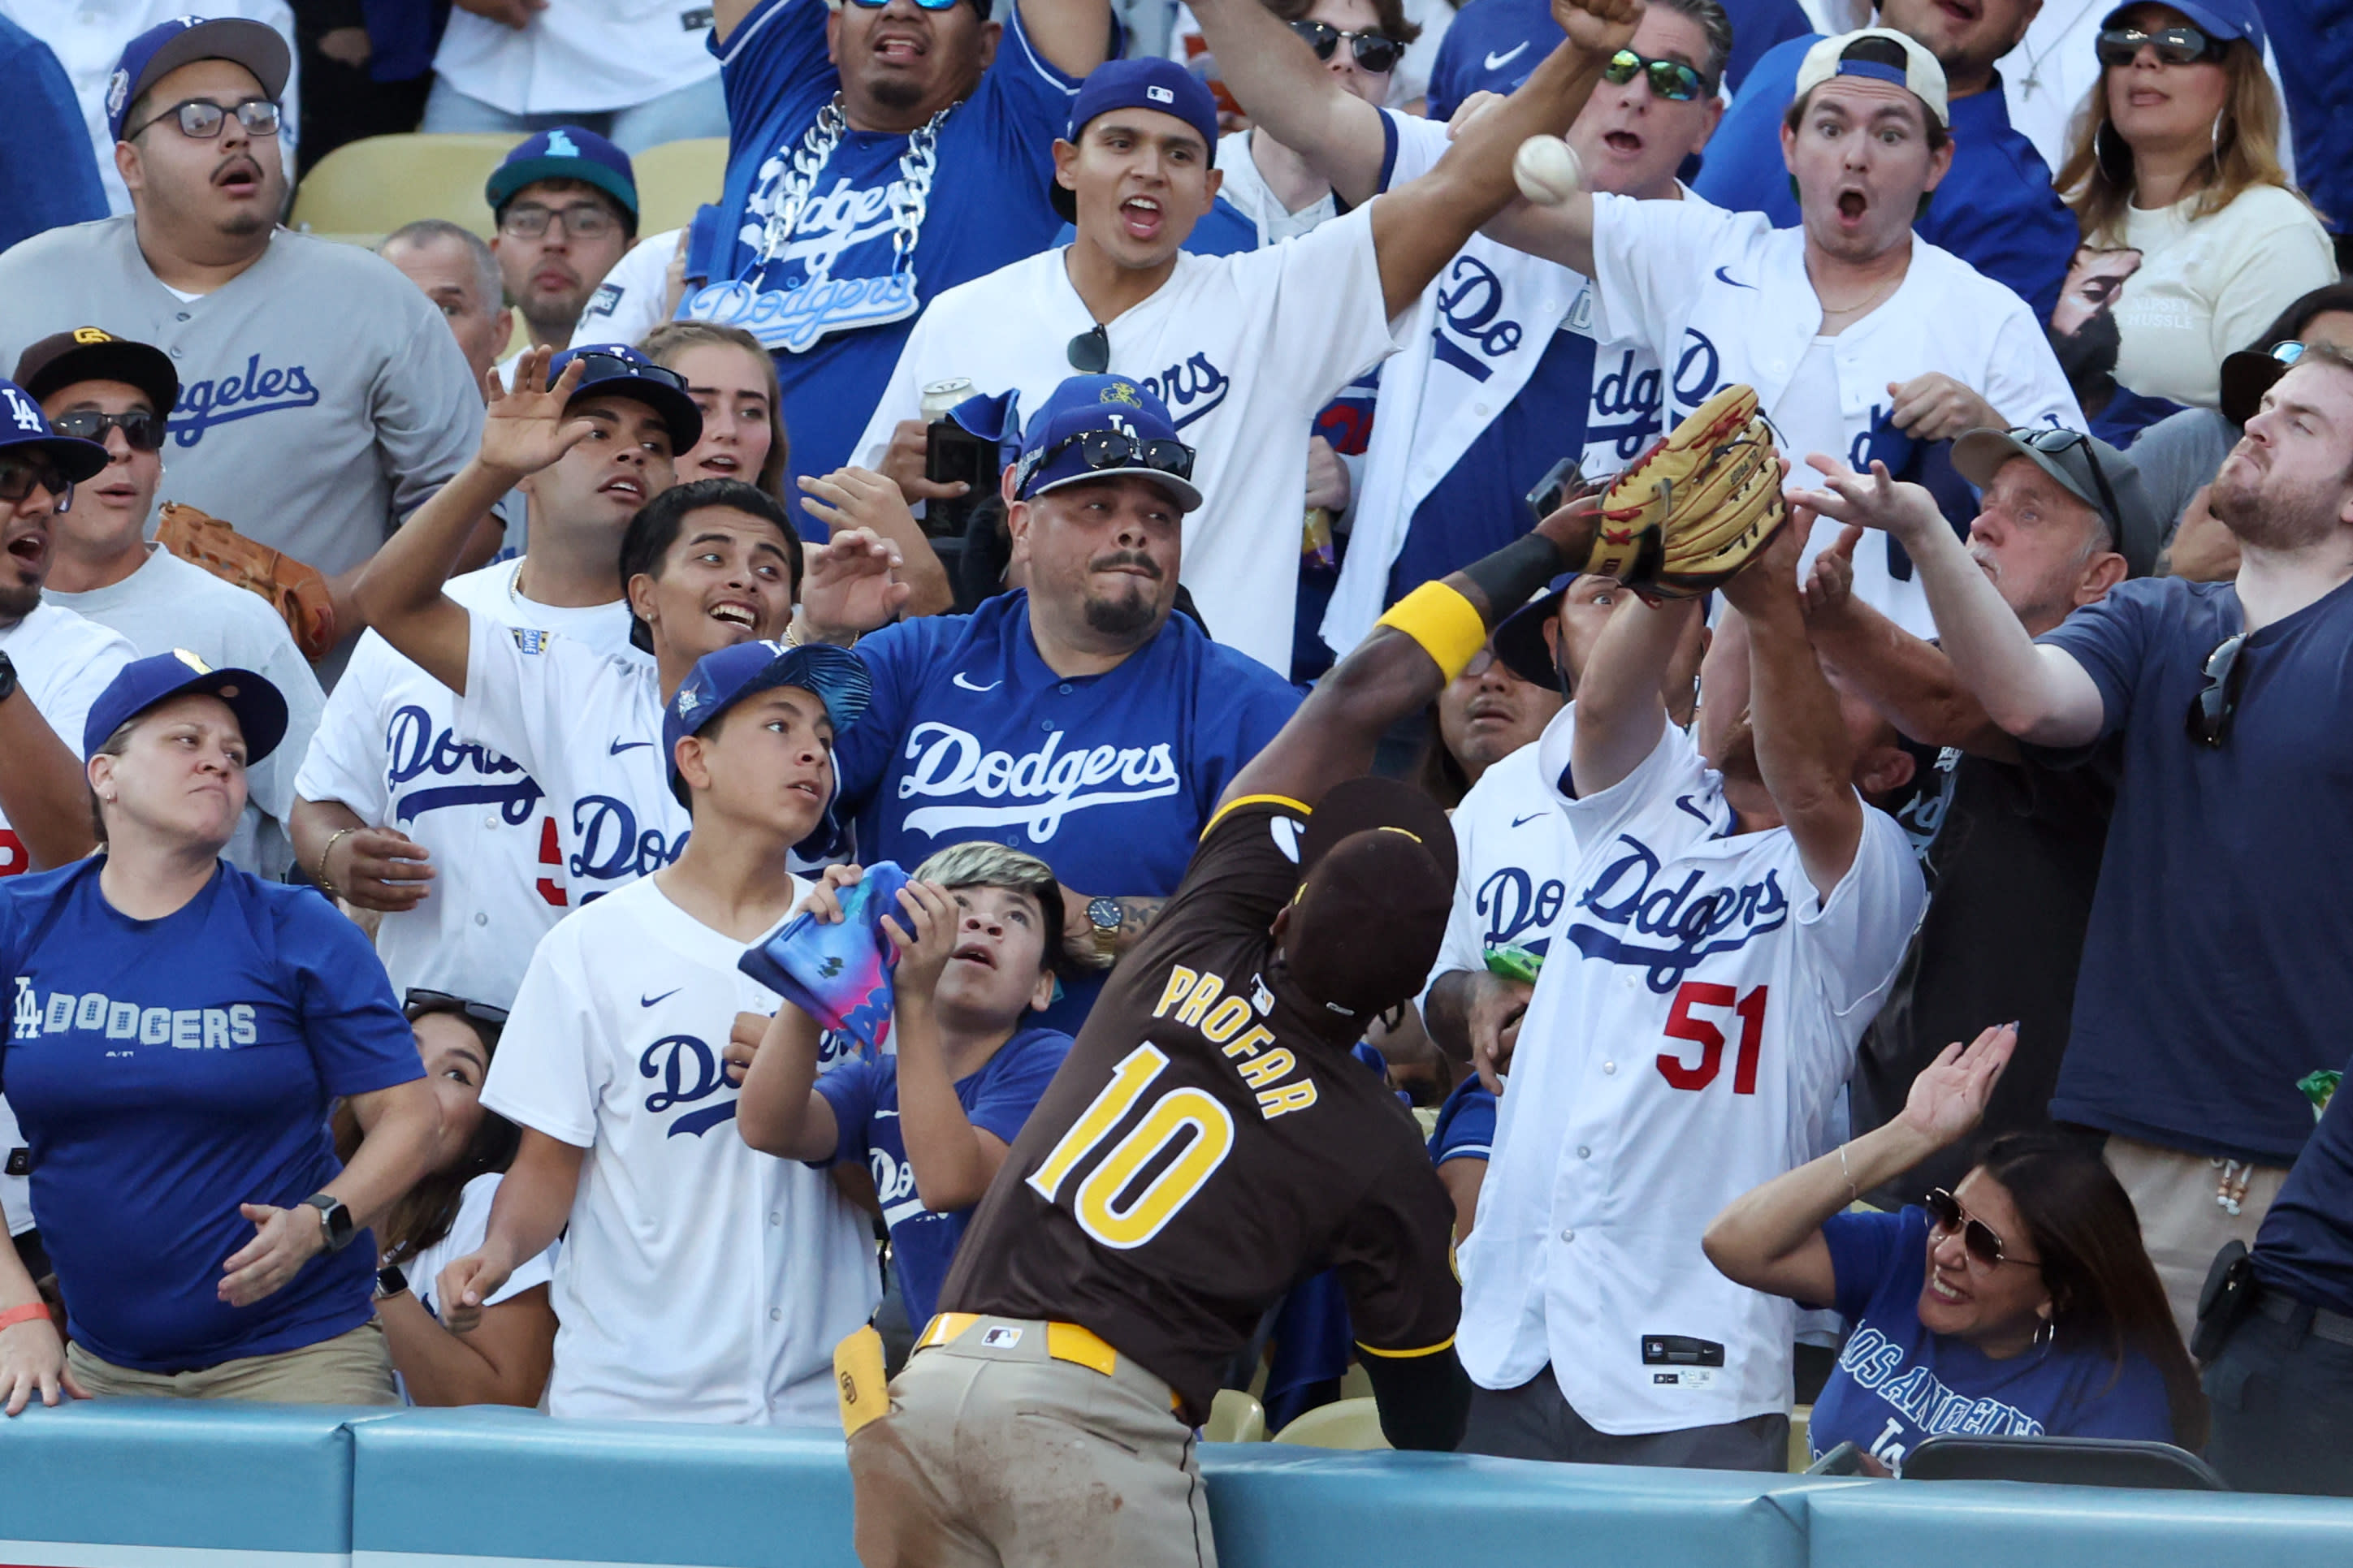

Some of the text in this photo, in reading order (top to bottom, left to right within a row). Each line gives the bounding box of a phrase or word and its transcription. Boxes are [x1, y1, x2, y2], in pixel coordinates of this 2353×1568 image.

[690, 273, 913, 347] Dodgers
[2, 388, 43, 433] LA
[898, 721, 1180, 844] Dodgers
[14, 976, 257, 1050] LA DODGERS
[1152, 964, 1318, 1121] PROFAR
[1656, 981, 1769, 1095] 51
[1025, 1039, 1235, 1250] 10
